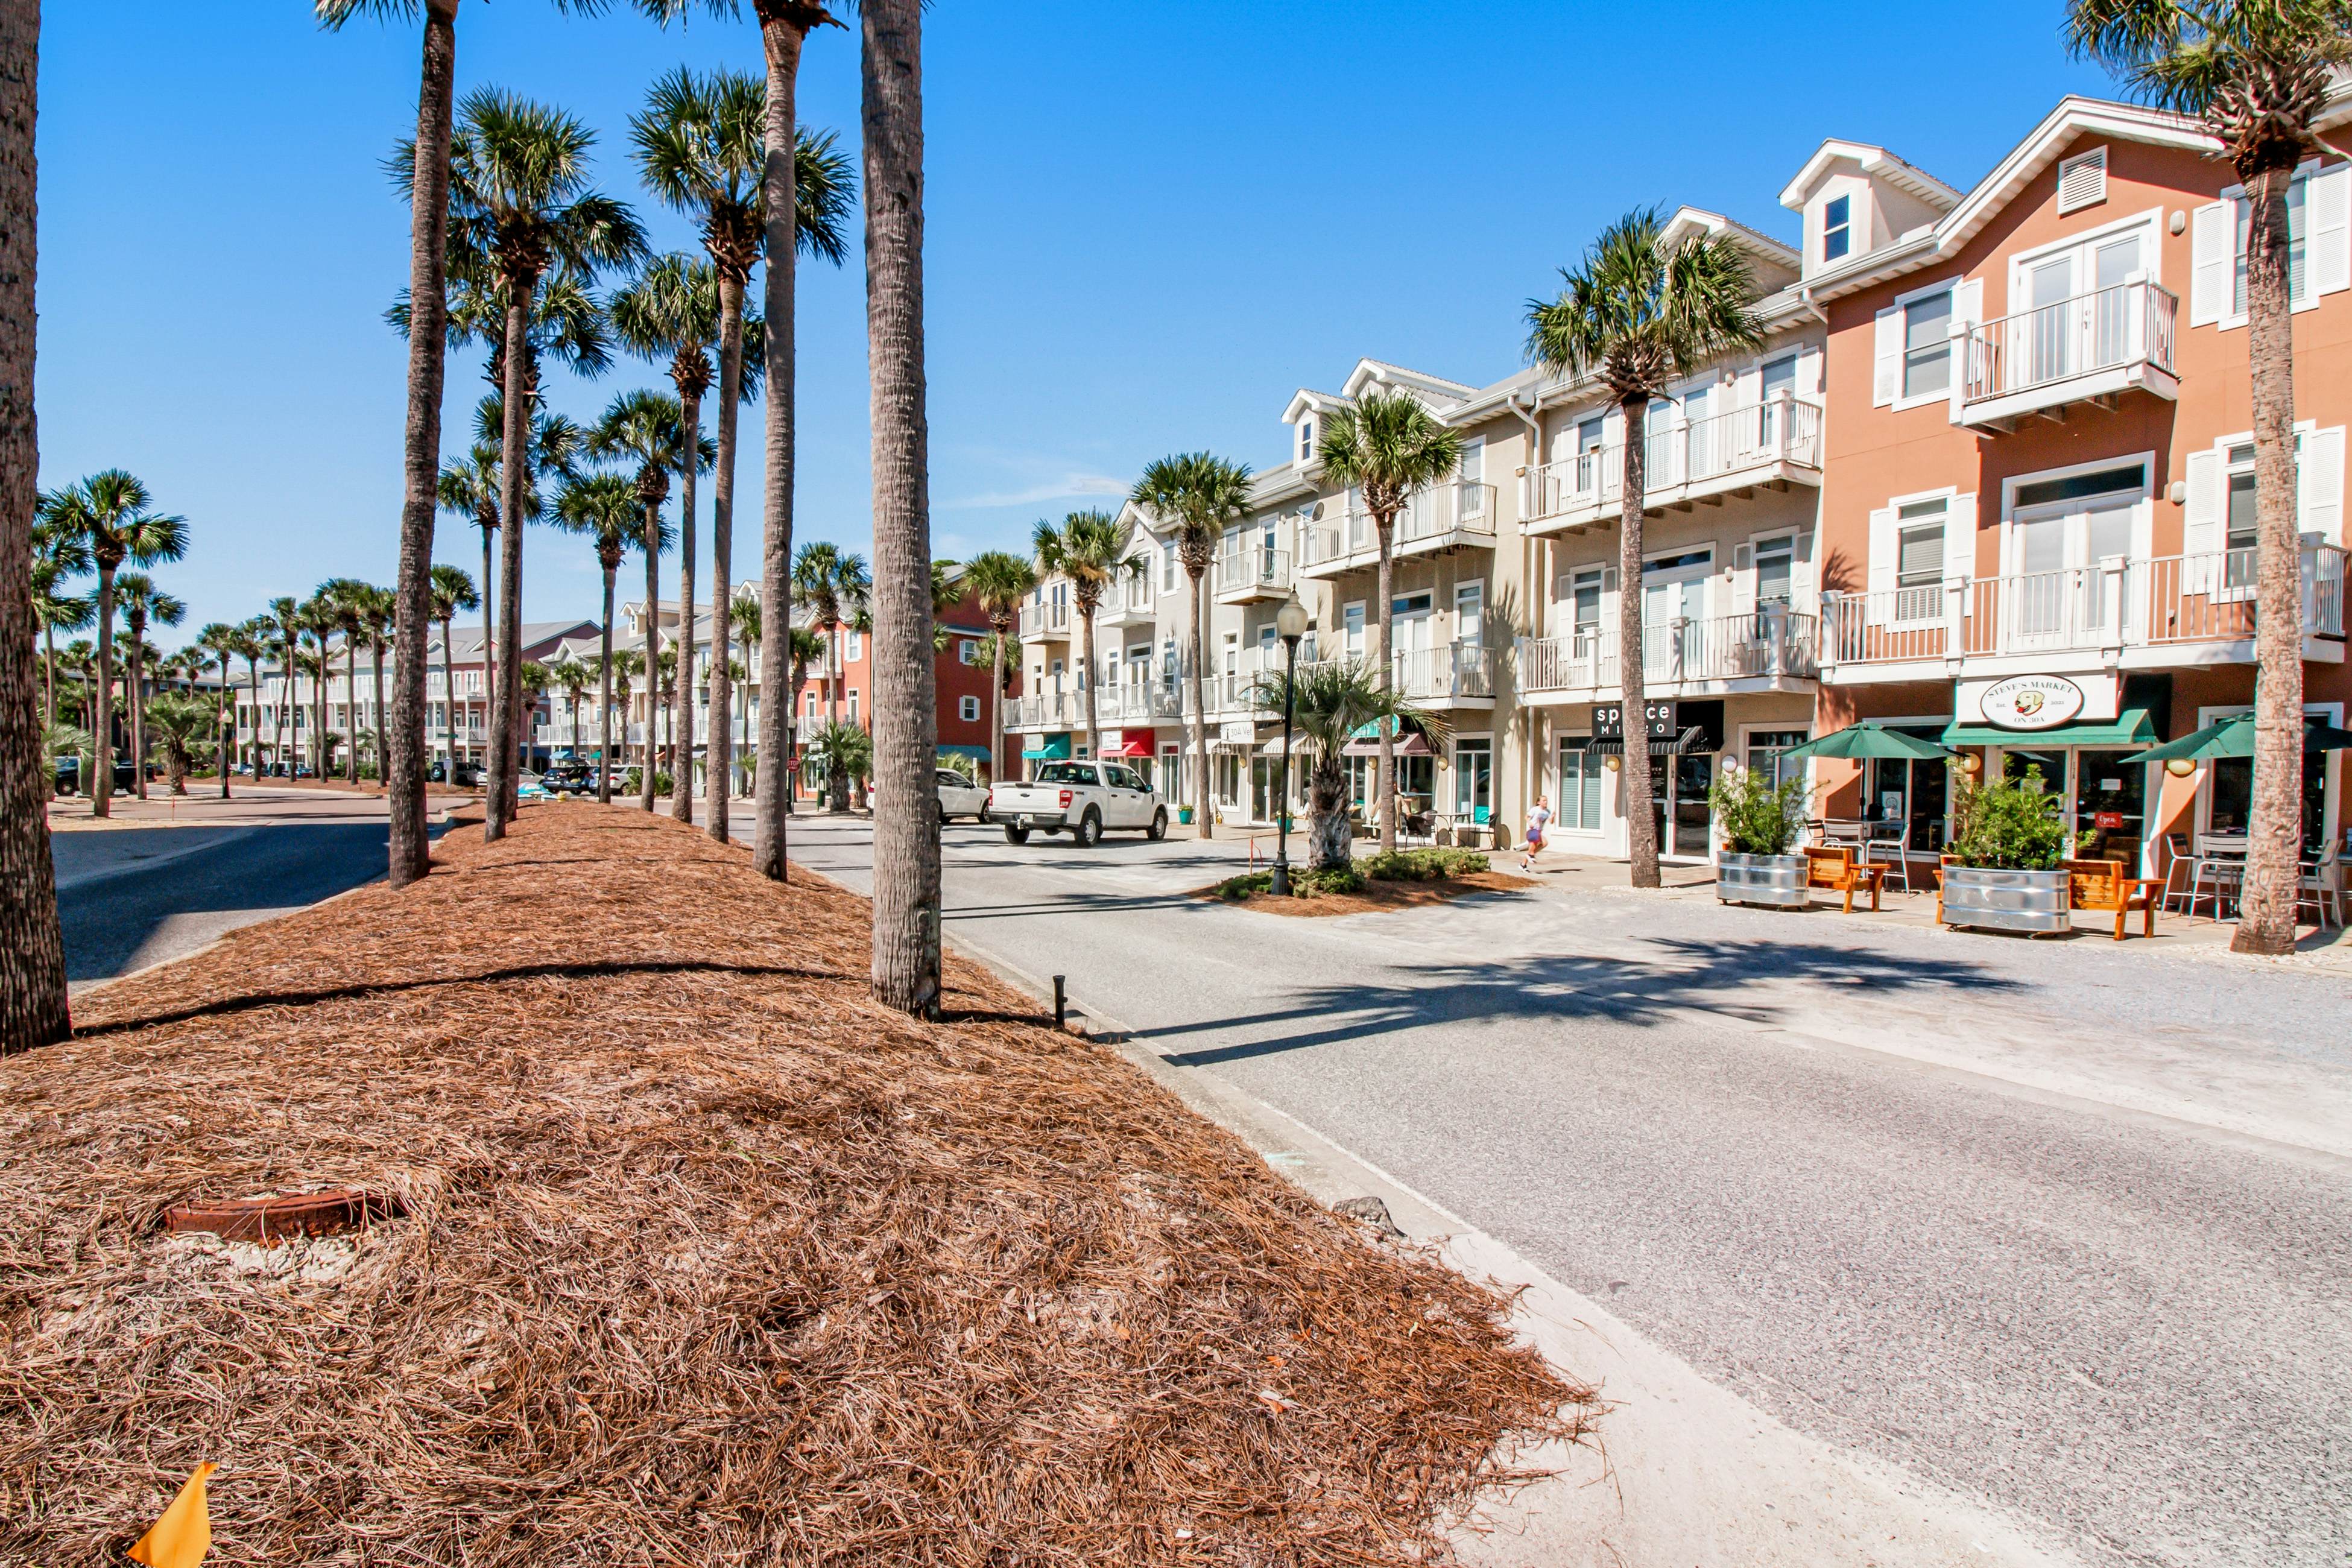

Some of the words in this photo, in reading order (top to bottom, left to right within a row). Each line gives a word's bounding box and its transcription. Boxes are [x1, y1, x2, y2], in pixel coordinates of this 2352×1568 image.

[1988, 681, 2027, 698] STEVE'S
[2031, 681, 2075, 694] MARKET
[1597, 706, 1669, 724] spce
[1242, 726, 1253, 736] Vet
[1601, 724, 1664, 735] MIO
[2099, 815, 2116, 824] Open
